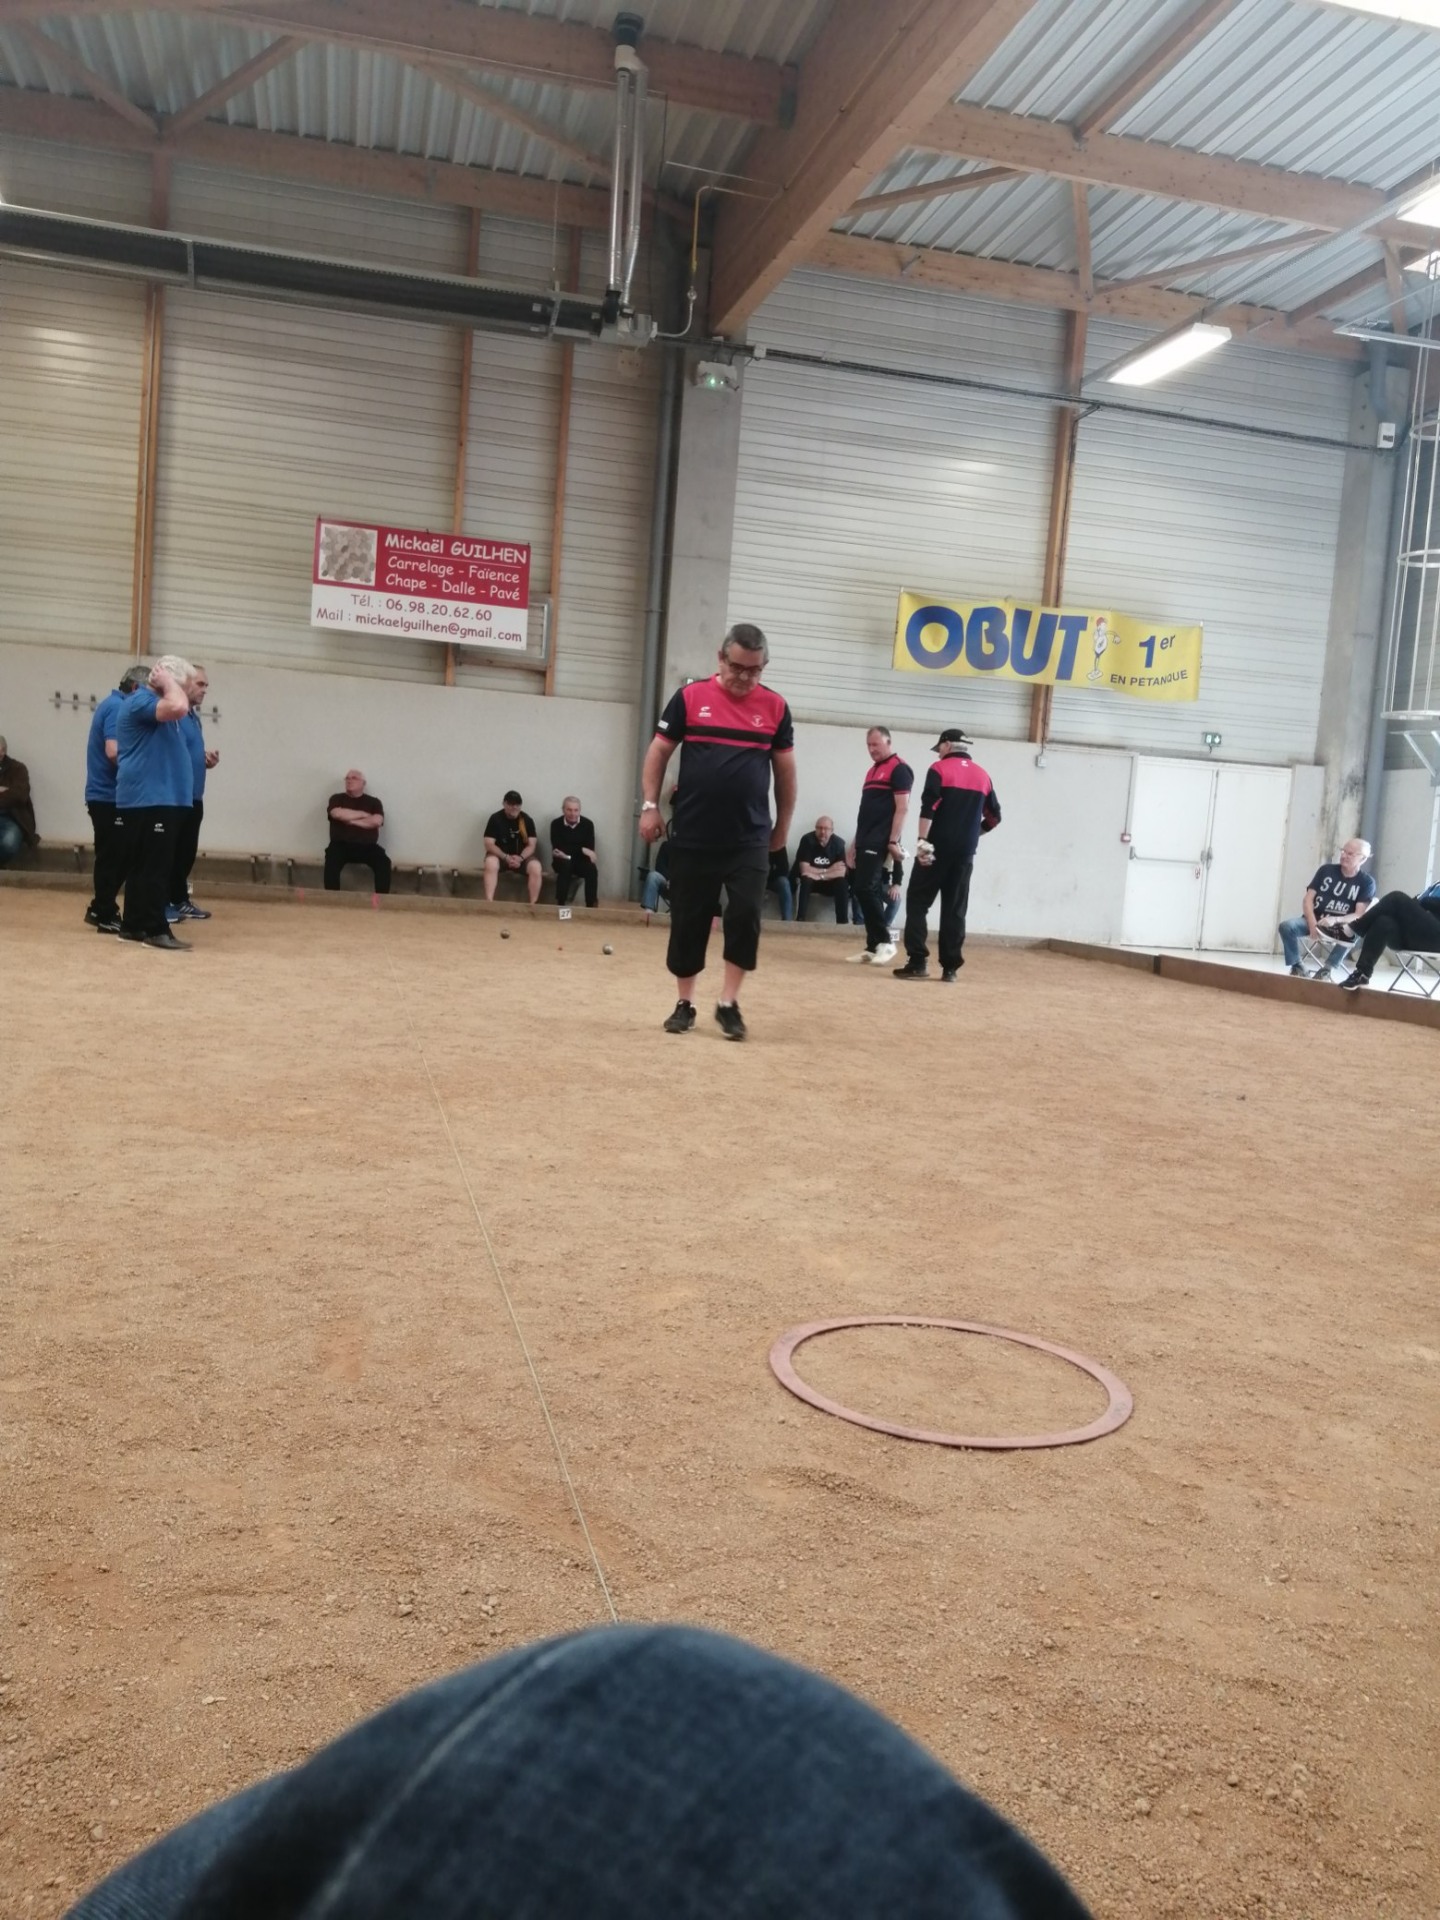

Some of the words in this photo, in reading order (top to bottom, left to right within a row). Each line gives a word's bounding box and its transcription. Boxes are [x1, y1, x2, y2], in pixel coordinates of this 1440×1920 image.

[385, 534, 443, 554] Mickaël
[451, 541, 527, 564] GUILHEN
[388, 556, 454, 577] Carrelage
[469, 566, 520, 583] Faïence
[385, 573, 427, 592] Chape
[442, 582, 476, 596] Dalle
[490, 587, 520, 601] Pavé
[316, 607, 344, 622] Mail
[356, 613, 522, 643] mickaelguilhen@gmail.com
[905, 605, 1088, 681] OBUT
[1110, 673, 1126, 686] EN
[1130, 669, 1189, 688] PETANQUE
[1319, 876, 1360, 901] SUN
[1326, 899, 1350, 912] AND
